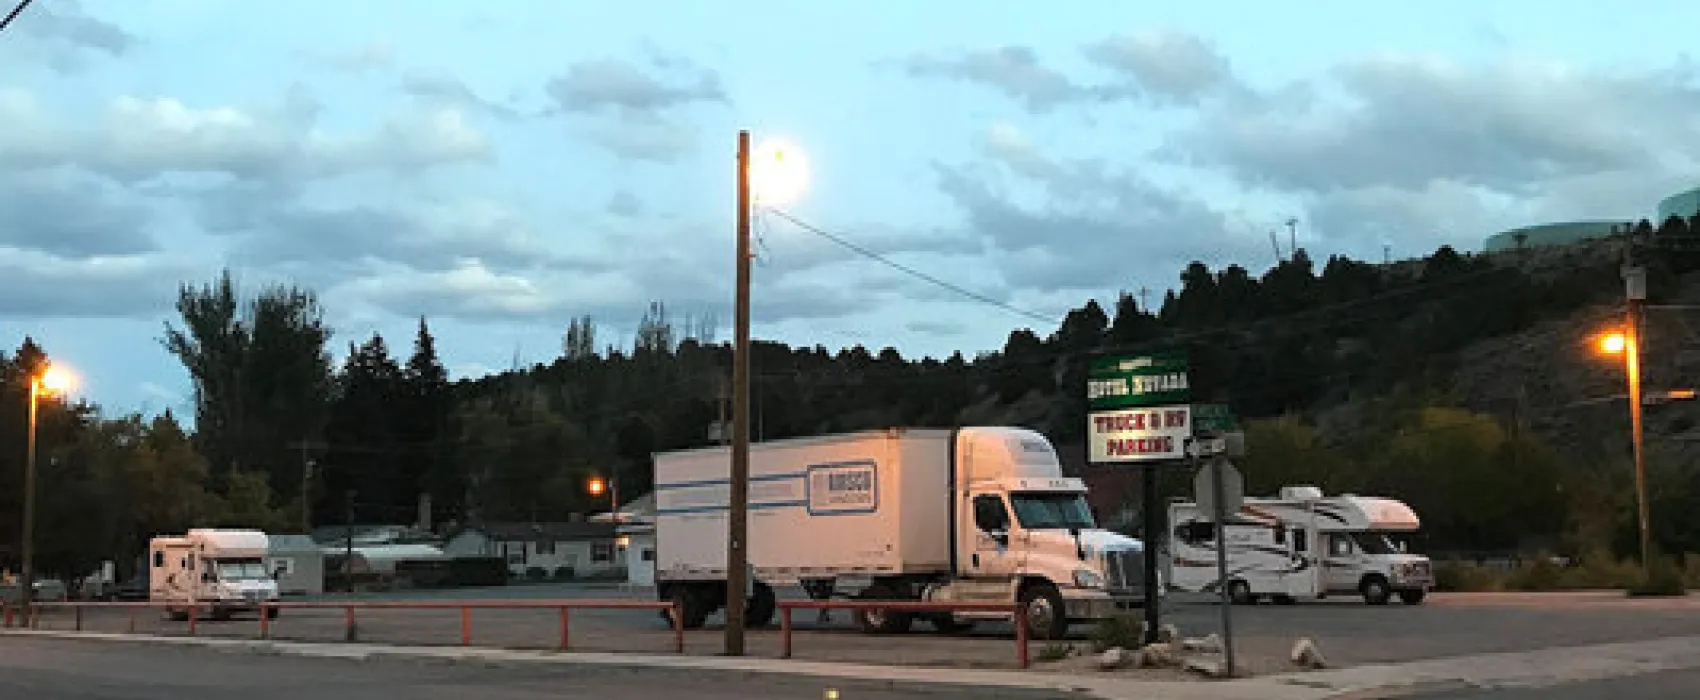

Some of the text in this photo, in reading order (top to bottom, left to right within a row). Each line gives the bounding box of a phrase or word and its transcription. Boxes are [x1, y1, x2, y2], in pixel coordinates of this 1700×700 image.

[1094, 413, 1145, 433] TRUCK
[1163, 410, 1186, 428] RV
[1106, 436, 1174, 456] PARKING
